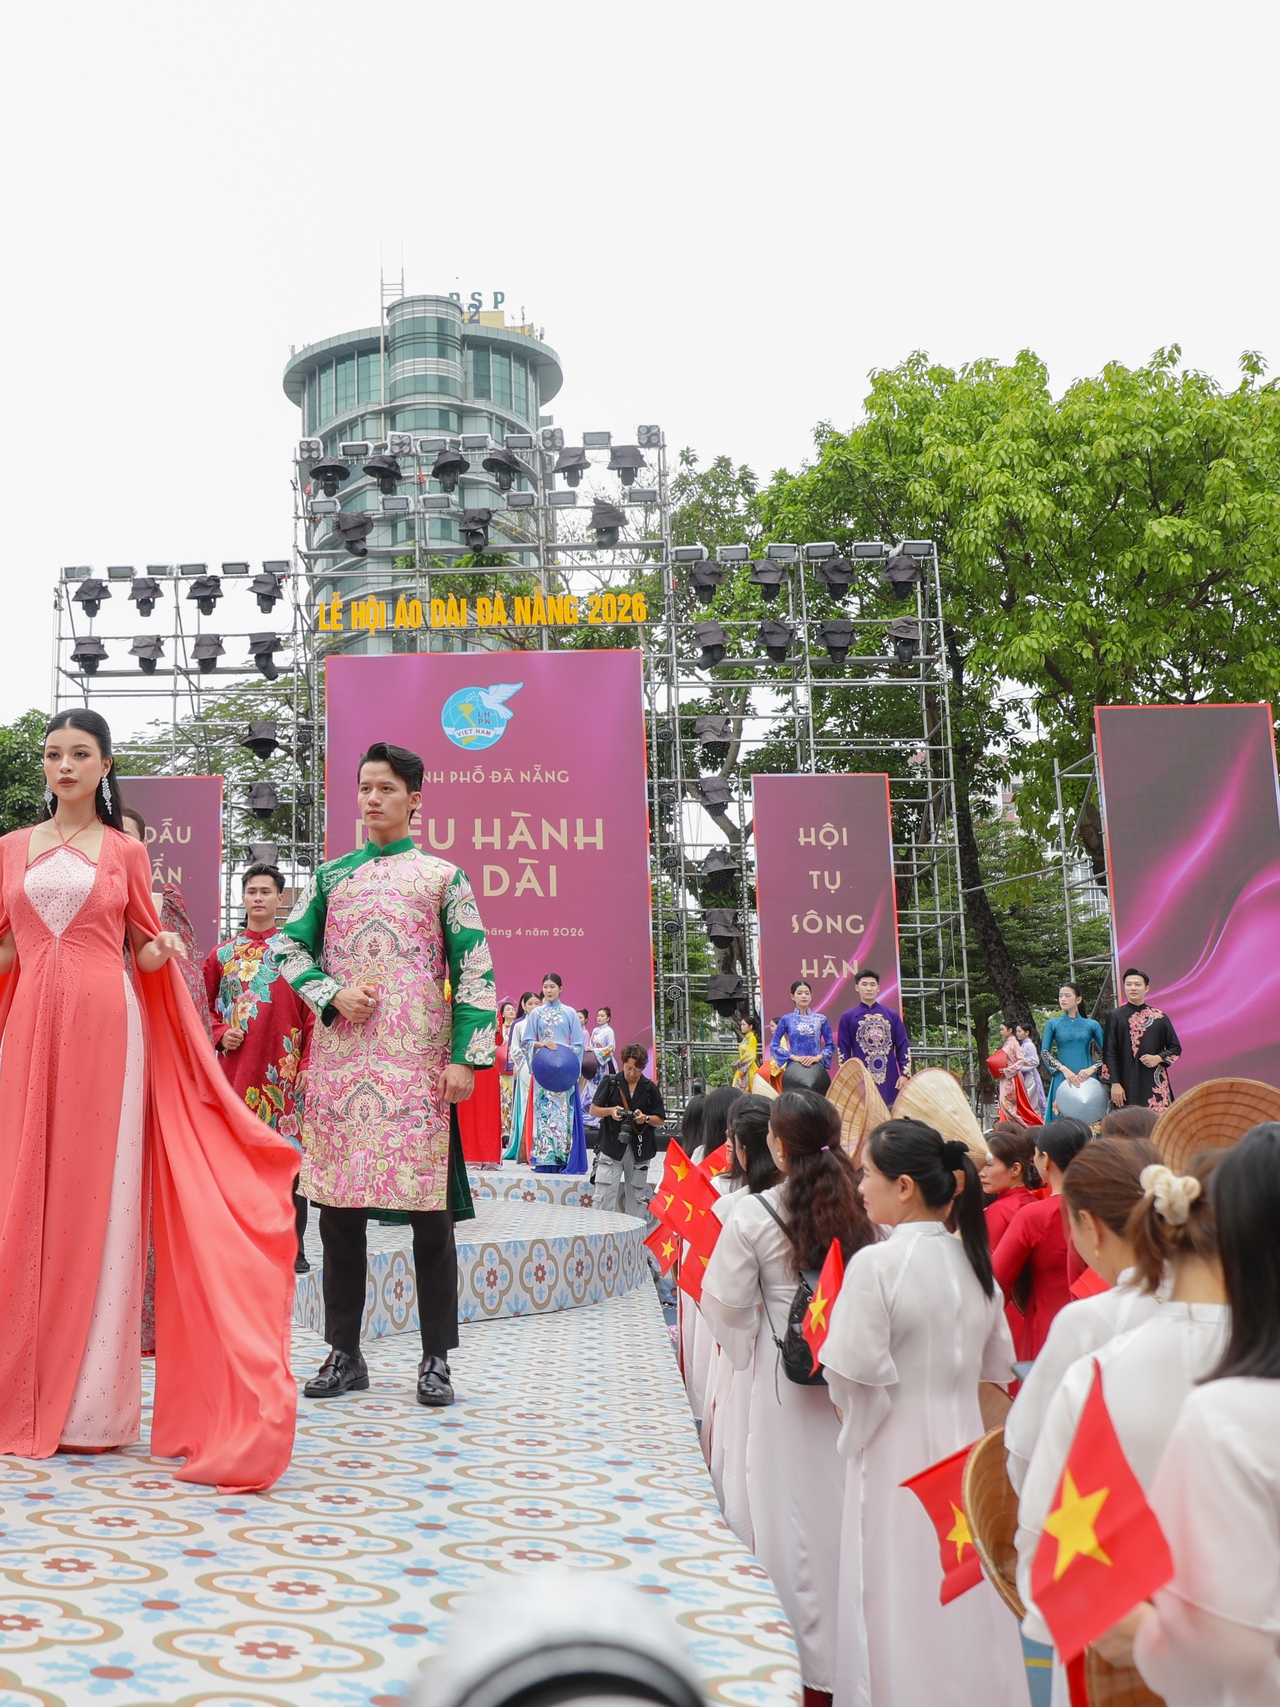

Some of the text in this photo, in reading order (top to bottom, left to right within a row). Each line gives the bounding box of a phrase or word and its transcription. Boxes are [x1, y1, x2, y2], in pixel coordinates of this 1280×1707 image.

[318, 591, 343, 631] LỄ
[351, 595, 385, 636] HỘI
[394, 593, 422, 628] ÁO
[430, 593, 467, 628] DÀI
[476, 590, 507, 627] ĐÀ
[588, 592, 647, 623] 2026
[475, 728, 491, 736] NAM
[489, 768, 515, 783] ĐÀ
[520, 764, 570, 783] NẴNG
[472, 811, 604, 850] HÀNH
[798, 822, 848, 850] HỘI
[482, 857, 557, 897] DÀI
[808, 870, 841, 894] TỤ
[515, 927, 522, 936] 4
[525, 927, 549, 936] năm
[552, 927, 585, 937] 2026
[791, 909, 865, 935] SÔNG
[800, 954, 859, 979] HÀN
